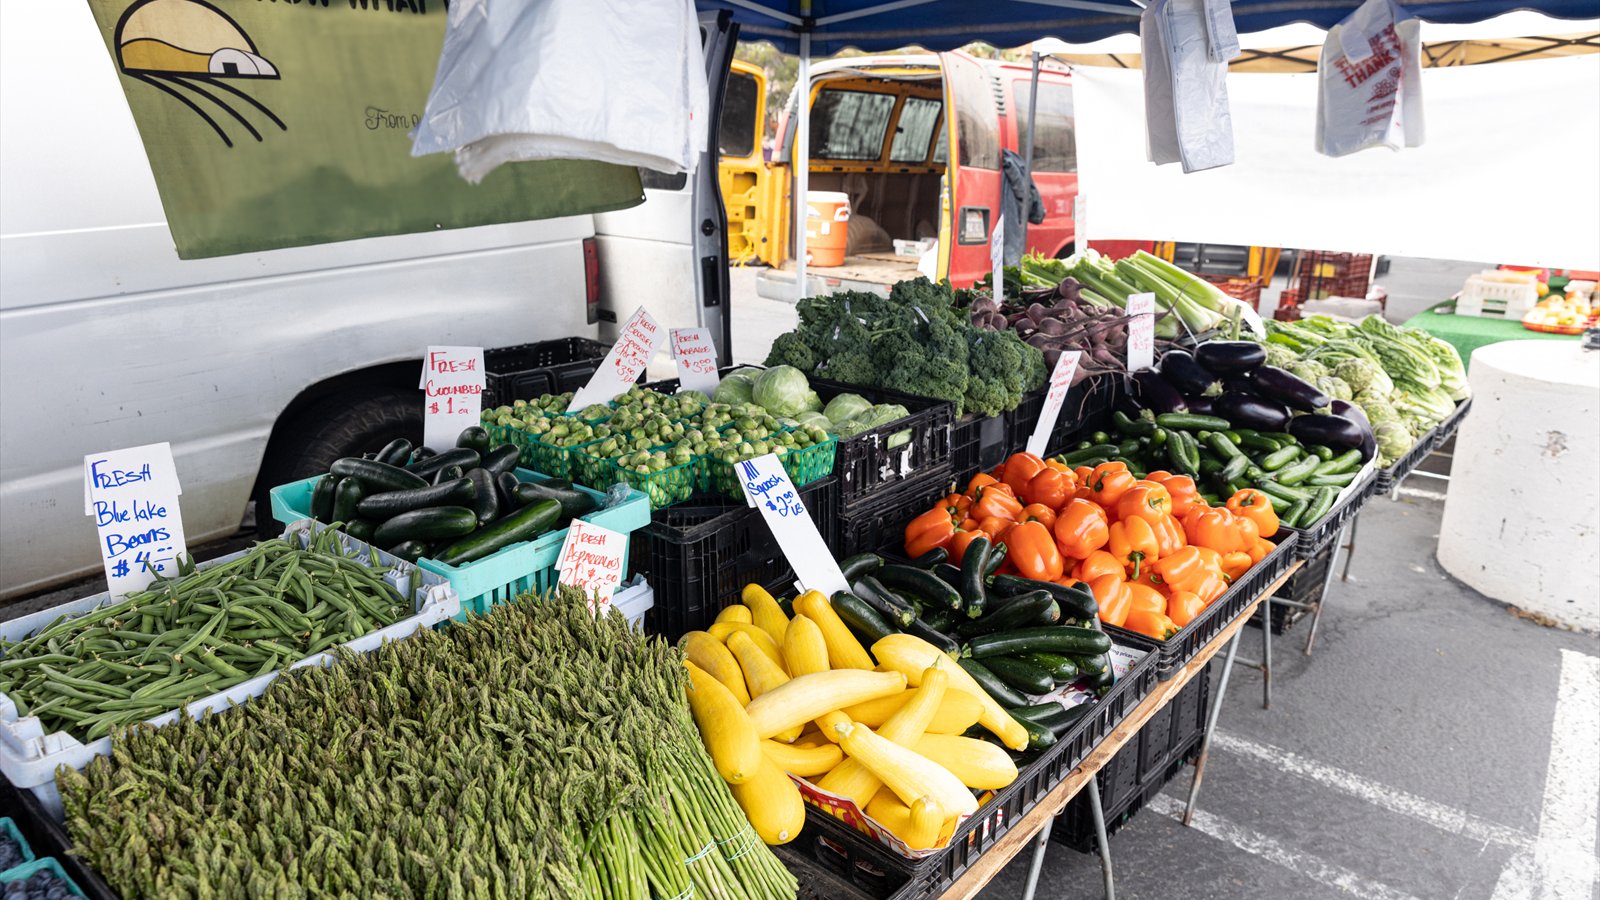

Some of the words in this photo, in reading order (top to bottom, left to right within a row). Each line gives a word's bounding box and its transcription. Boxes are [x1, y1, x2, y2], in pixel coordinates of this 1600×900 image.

[1345, 49, 1395, 88] THANK
[365, 106, 409, 130] From
[635, 310, 657, 334] FRESH
[671, 330, 700, 343] FRESH
[430, 351, 476, 374] FRESH
[92, 459, 152, 489] FRESH
[741, 460, 760, 481] All
[747, 474, 784, 499] Squash
[94, 500, 131, 527] Blue
[106, 528, 170, 558] Beans
[573, 524, 607, 545] FRESH
[1119, 651, 1133, 659] prices
